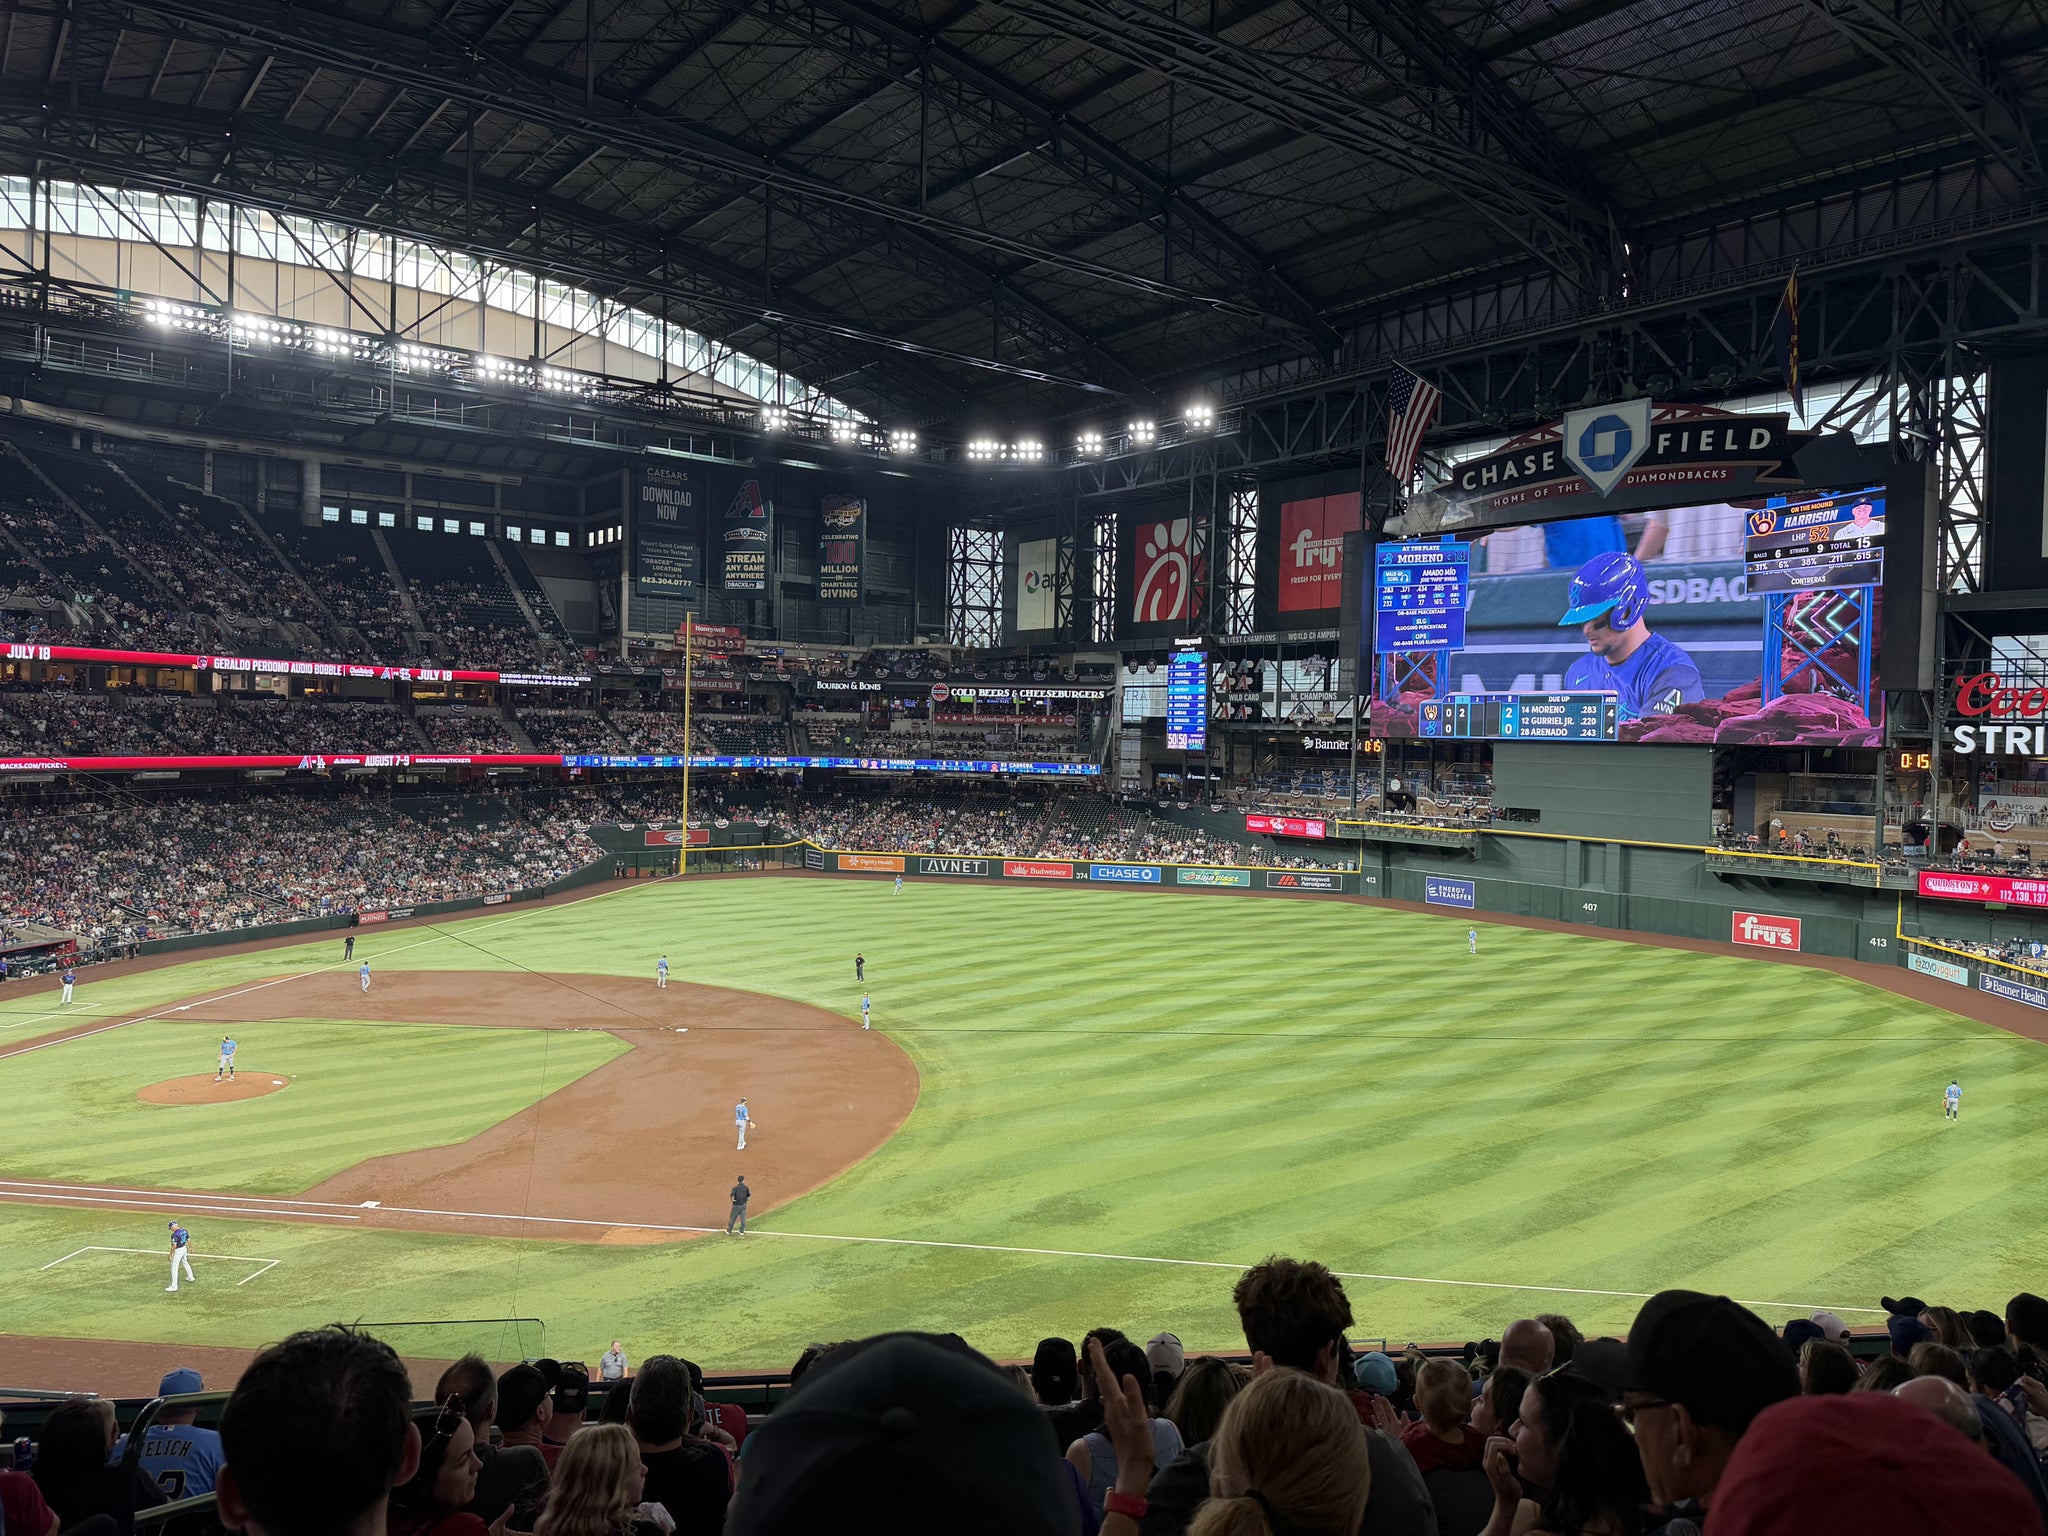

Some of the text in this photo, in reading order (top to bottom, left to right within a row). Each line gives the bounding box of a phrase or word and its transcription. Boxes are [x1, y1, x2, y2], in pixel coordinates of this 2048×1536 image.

[1462, 427, 1773, 492] CHASE FIELD
[646, 467, 688, 481] CAESARS
[1493, 469, 1728, 508] HOME OF THE DIAMONDBACKS
[642, 485, 692, 507] DOWNLOAD
[1811, 501, 1834, 510] MOUND
[656, 503, 679, 521] NOW
[1783, 509, 1839, 528] HARRISON
[1791, 526, 1830, 543] LHP 52
[819, 540, 856, 564] $100
[1774, 549, 1782, 559] 6
[1789, 546, 1810, 555] STRIKES
[1816, 544, 1824, 553] 9
[1830, 543, 1852, 551] TOTAL
[1855, 537, 1871, 549] 15
[725, 554, 765, 564] STREAM
[1397, 553, 1444, 564] MORENO
[1754, 563, 1768, 571] 31%
[1778, 560, 1789, 569] 6%
[1801, 557, 1817, 566] 38%
[1828, 554, 1843, 563] .211
[1853, 552, 1871, 561] .615
[652, 564, 682, 573] LOCATION
[743, 564, 765, 572] GAME
[820, 565, 859, 574] MILLION
[641, 576, 693, 587] 623.304.0777
[725, 572, 765, 580] ANYWHERE
[1290, 576, 1309, 584] FRESH
[1309, 574, 1322, 582] FOR
[1790, 575, 1827, 585] CONTRERAS
[820, 588, 858, 598] GIVING
[695, 625, 726, 634] Honeywell
[1243, 634, 1276, 643] CHAMPIONS
[1287, 632, 1308, 641] WORLD
[6, 644, 51, 661] JULY 18
[213, 658, 251, 671] GERALDO
[252, 660, 289, 673] PERDOMO
[290, 661, 313, 674] AUDIO
[314, 663, 342, 676] BOBBLE
[417, 669, 439, 681] JULY
[442, 670, 453, 682] 18
[717, 681, 733, 689] SEATS
[850, 681, 858, 690] &
[950, 688, 977, 697] COLD
[978, 688, 1010, 697] BEERS
[1011, 689, 1018, 698] &
[1019, 689, 1105, 699] CHEESEBURGERS
[1228, 692, 1260, 702] WILD CARD
[1290, 691, 1338, 701] NL CHAMPIONS
[1955, 671, 2048, 717] Coo
[1445, 707, 1513, 719] 0 2 2
[1521, 705, 1615, 718] 14 MORENO .283 4
[1521, 716, 1597, 727] 12 GURRIEL JR. .220
[1445, 723, 1513, 735] 0 0
[1520, 725, 1614, 737] 28 ARENADO .243 4
[1314, 738, 1350, 750] Banner
[1364, 739, 1382, 752] 0:15
[1953, 725, 2046, 755] STRI
[364, 755, 394, 767] AUGUST
[395, 755, 410, 767] 7-9
[1900, 752, 1931, 770] 0:15
[860, 858, 877, 866] Dignity
[927, 859, 982, 874] AVNET
[1030, 866, 1067, 877] Budweiser
[1075, 872, 1089, 880] 374
[1098, 867, 1140, 879] CHASE
[1300, 875, 1331, 883] Honeywell
[1365, 875, 1377, 884] 413
[1300, 881, 1332, 889] Aerospace
[1438, 885, 1466, 894] ENERGY
[1926, 877, 1949, 889] COLD
[1950, 878, 1979, 893] STONE
[2011, 881, 2046, 891] LOCATED IN
[1438, 891, 1472, 901] TRANSFER
[1582, 902, 1598, 912] 407
[1739, 915, 1794, 946] fry's
[1869, 937, 1887, 948] 413
[1992, 979, 2047, 1005] Banner Health
[141, 1439, 193, 1457] ELICH
